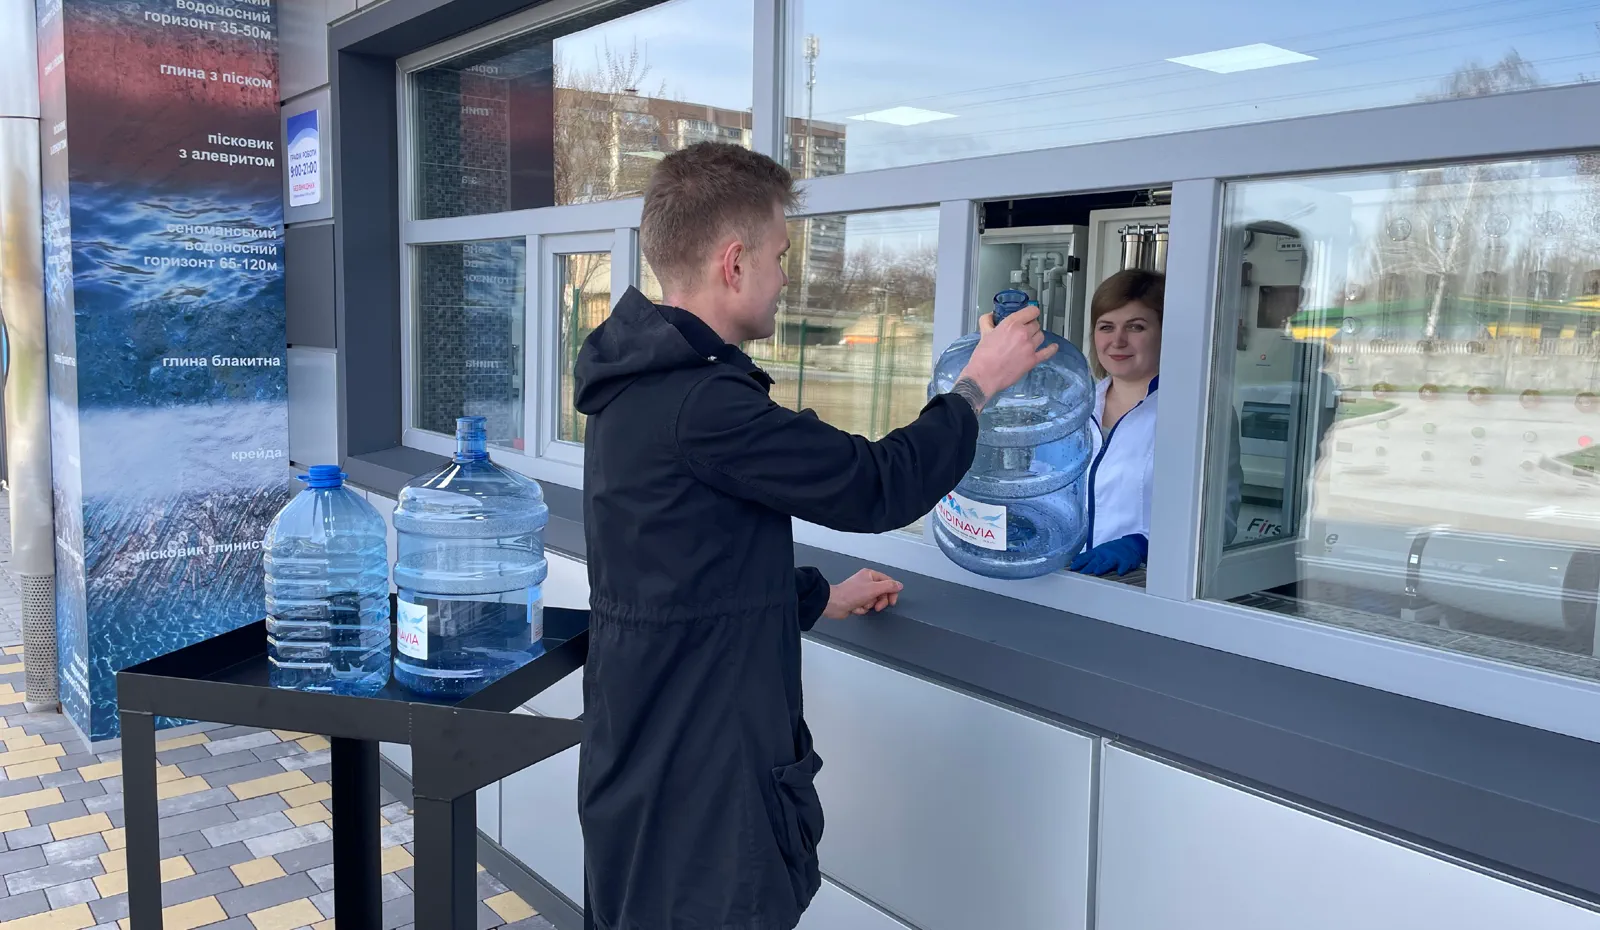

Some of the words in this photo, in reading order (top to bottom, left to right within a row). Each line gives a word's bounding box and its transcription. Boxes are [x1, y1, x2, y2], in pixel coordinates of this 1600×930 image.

[176, 0, 271, 24] водоносний
[144, 10, 217, 31] горизонт
[220, 20, 272, 41] 35-50м
[160, 64, 206, 80] глина
[210, 71, 218, 81] з
[222, 72, 272, 89] піском
[207, 132, 274, 150] пісковик
[178, 148, 188, 159] з
[191, 149, 275, 168] алевритом
[167, 223, 277, 240] сеноманський
[184, 241, 277, 256] водоносний
[143, 256, 216, 269] горизонт
[219, 257, 278, 272] 65-120м
[162, 357, 208, 367] глина
[211, 354, 281, 367] блакитна
[231, 447, 282, 462] крейда
[937, 503, 995, 540] NDINAVIA
[135, 549, 204, 562] пісковик
[208, 540, 265, 555] глинист
